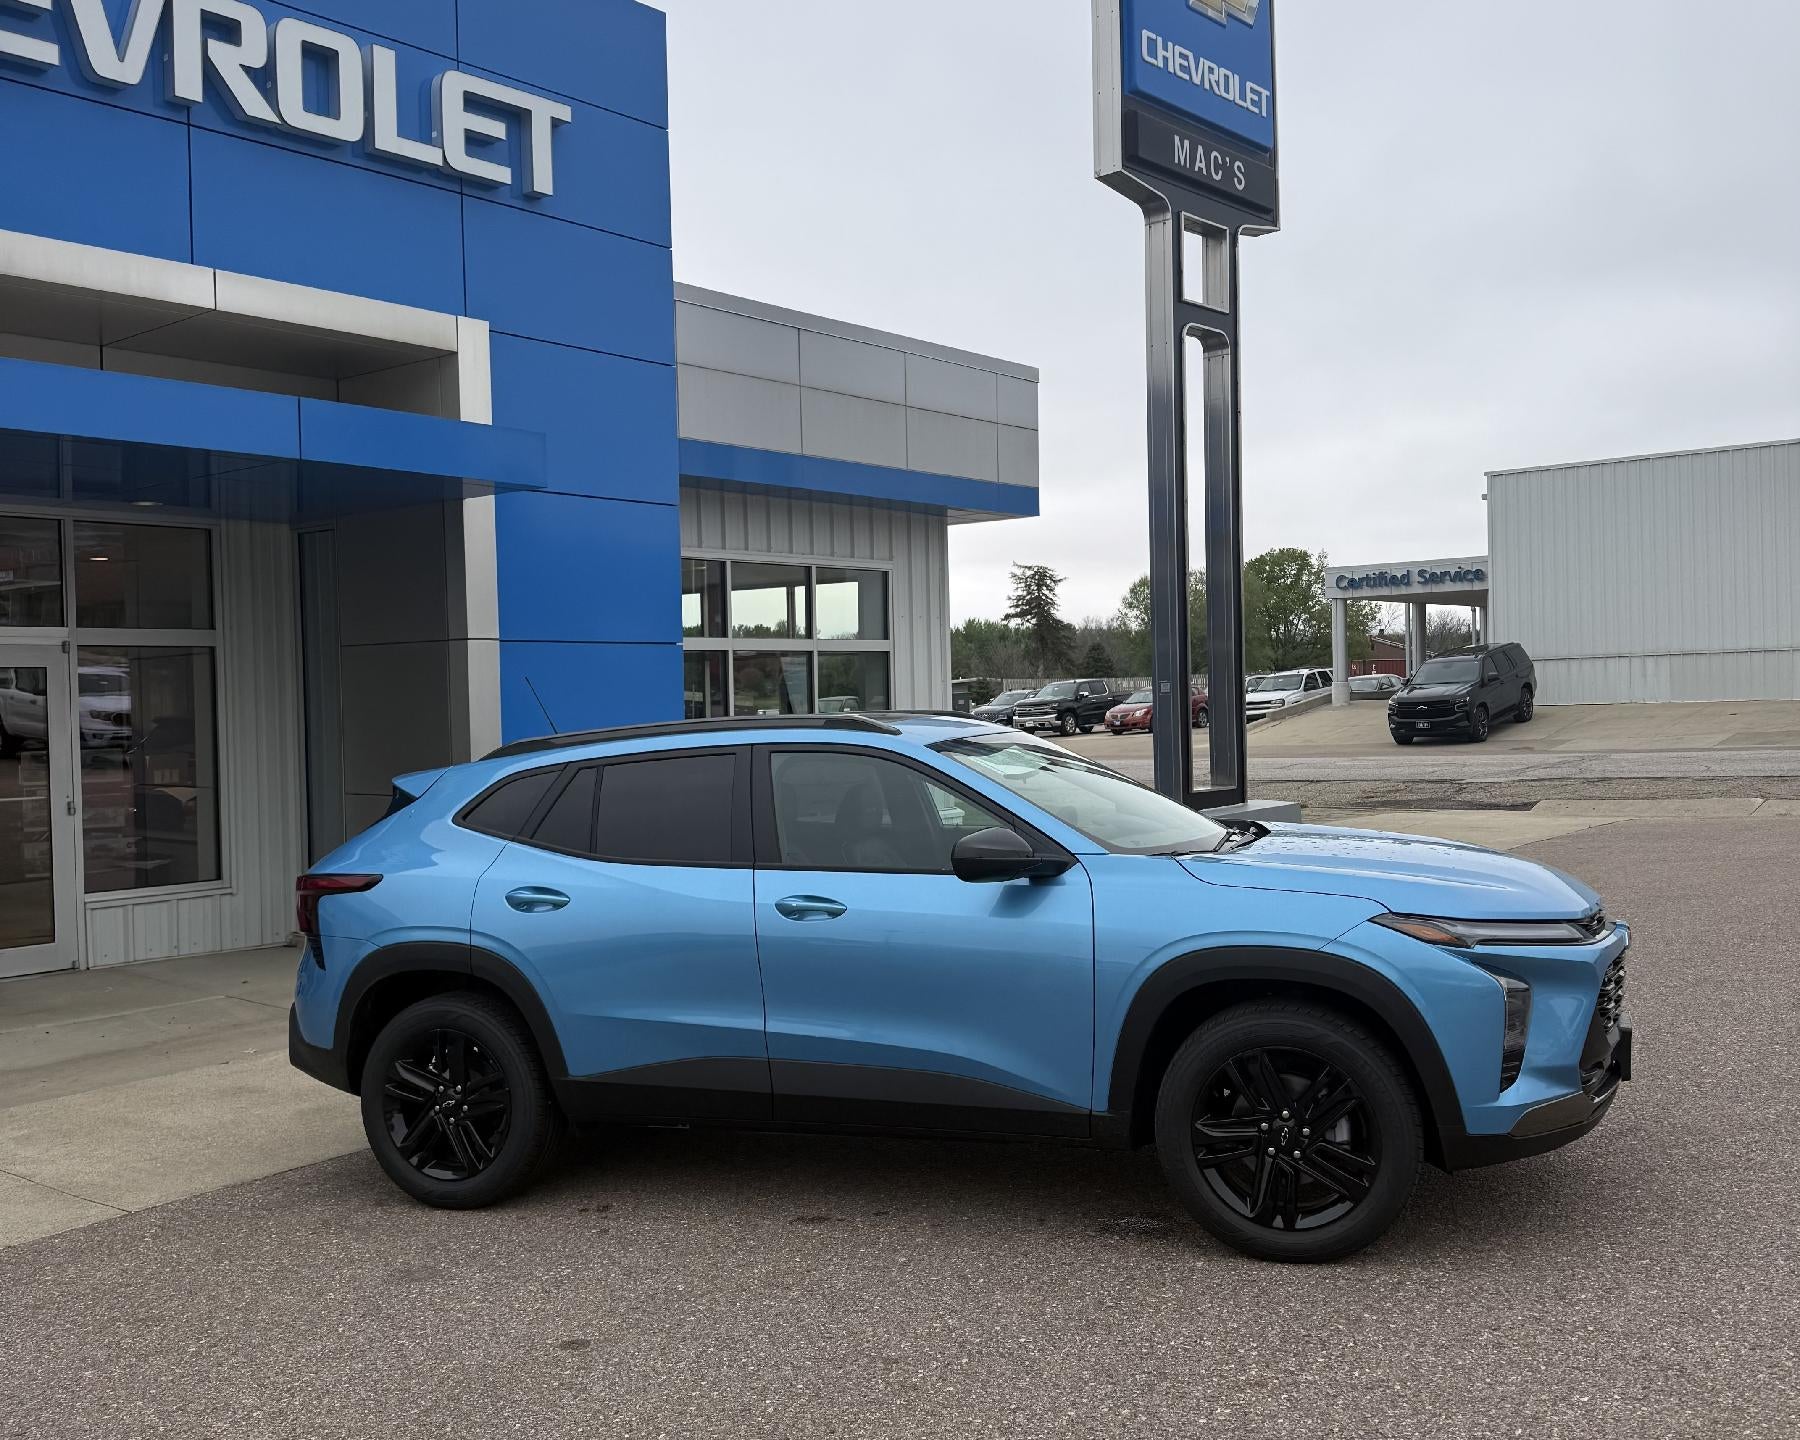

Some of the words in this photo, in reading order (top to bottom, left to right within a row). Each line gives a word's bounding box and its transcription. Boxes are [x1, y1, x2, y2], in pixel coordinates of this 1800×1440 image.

[1141, 29, 1270, 118] CHEVROLET
[1174, 134, 1246, 191] MAC'S
[1335, 569, 1411, 591] Certified
[1417, 566, 1485, 586] Service
